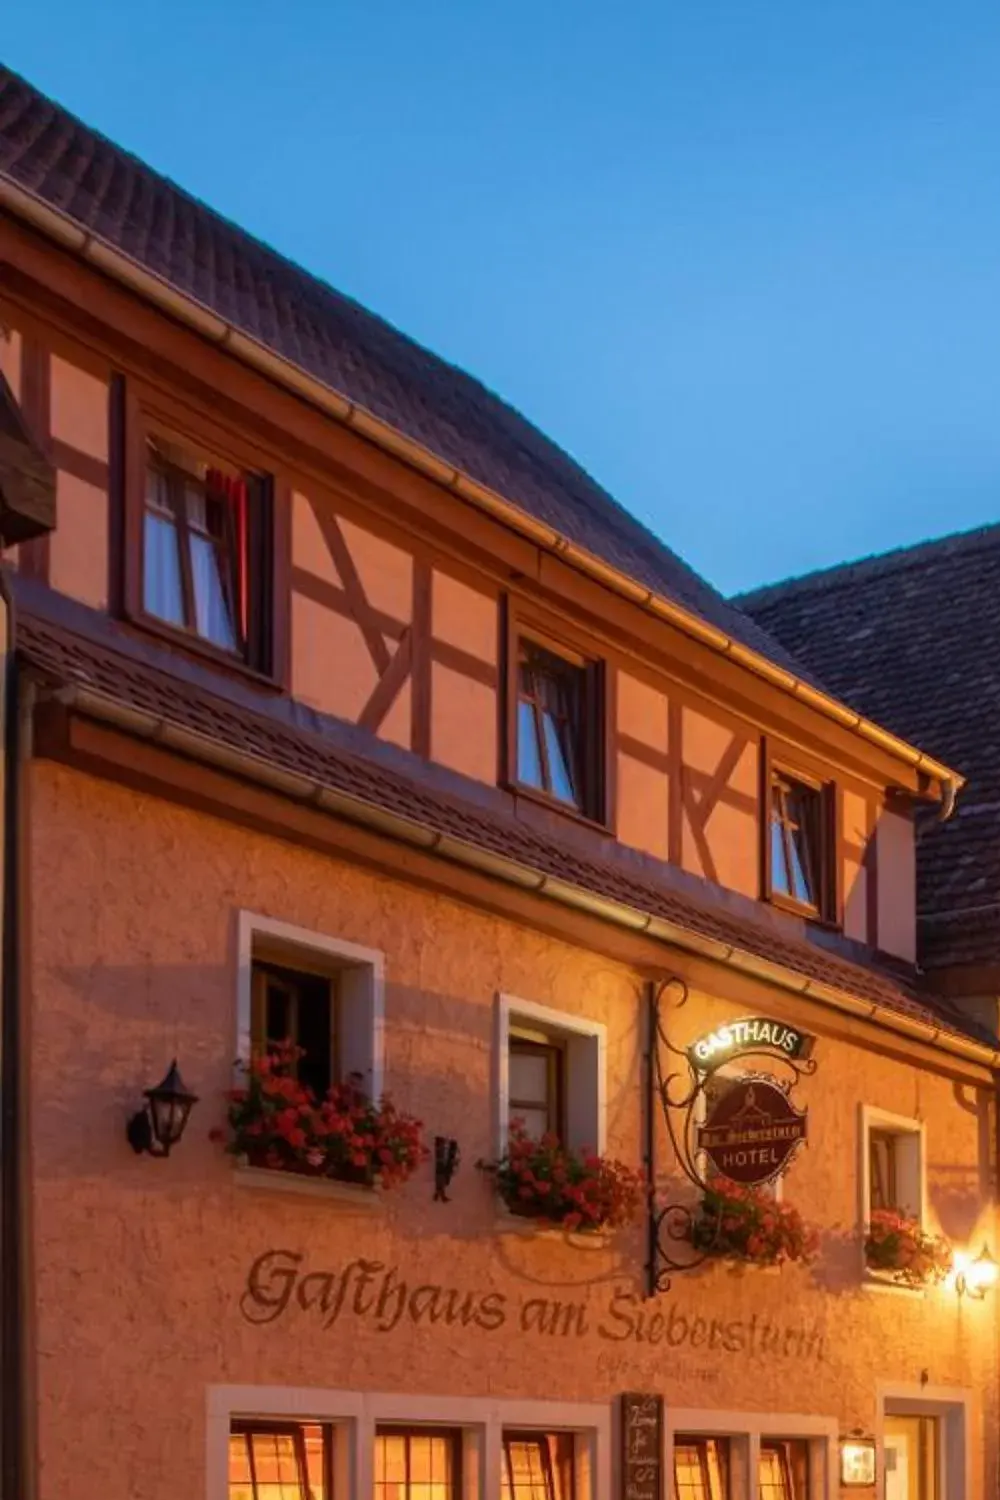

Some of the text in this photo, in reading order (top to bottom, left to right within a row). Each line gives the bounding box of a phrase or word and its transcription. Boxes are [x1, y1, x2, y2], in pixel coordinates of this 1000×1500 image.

[695, 1021, 799, 1060] GASTHAUS
[722, 1147, 779, 1167] HOTEL
[518, 1297, 590, 1338] am
